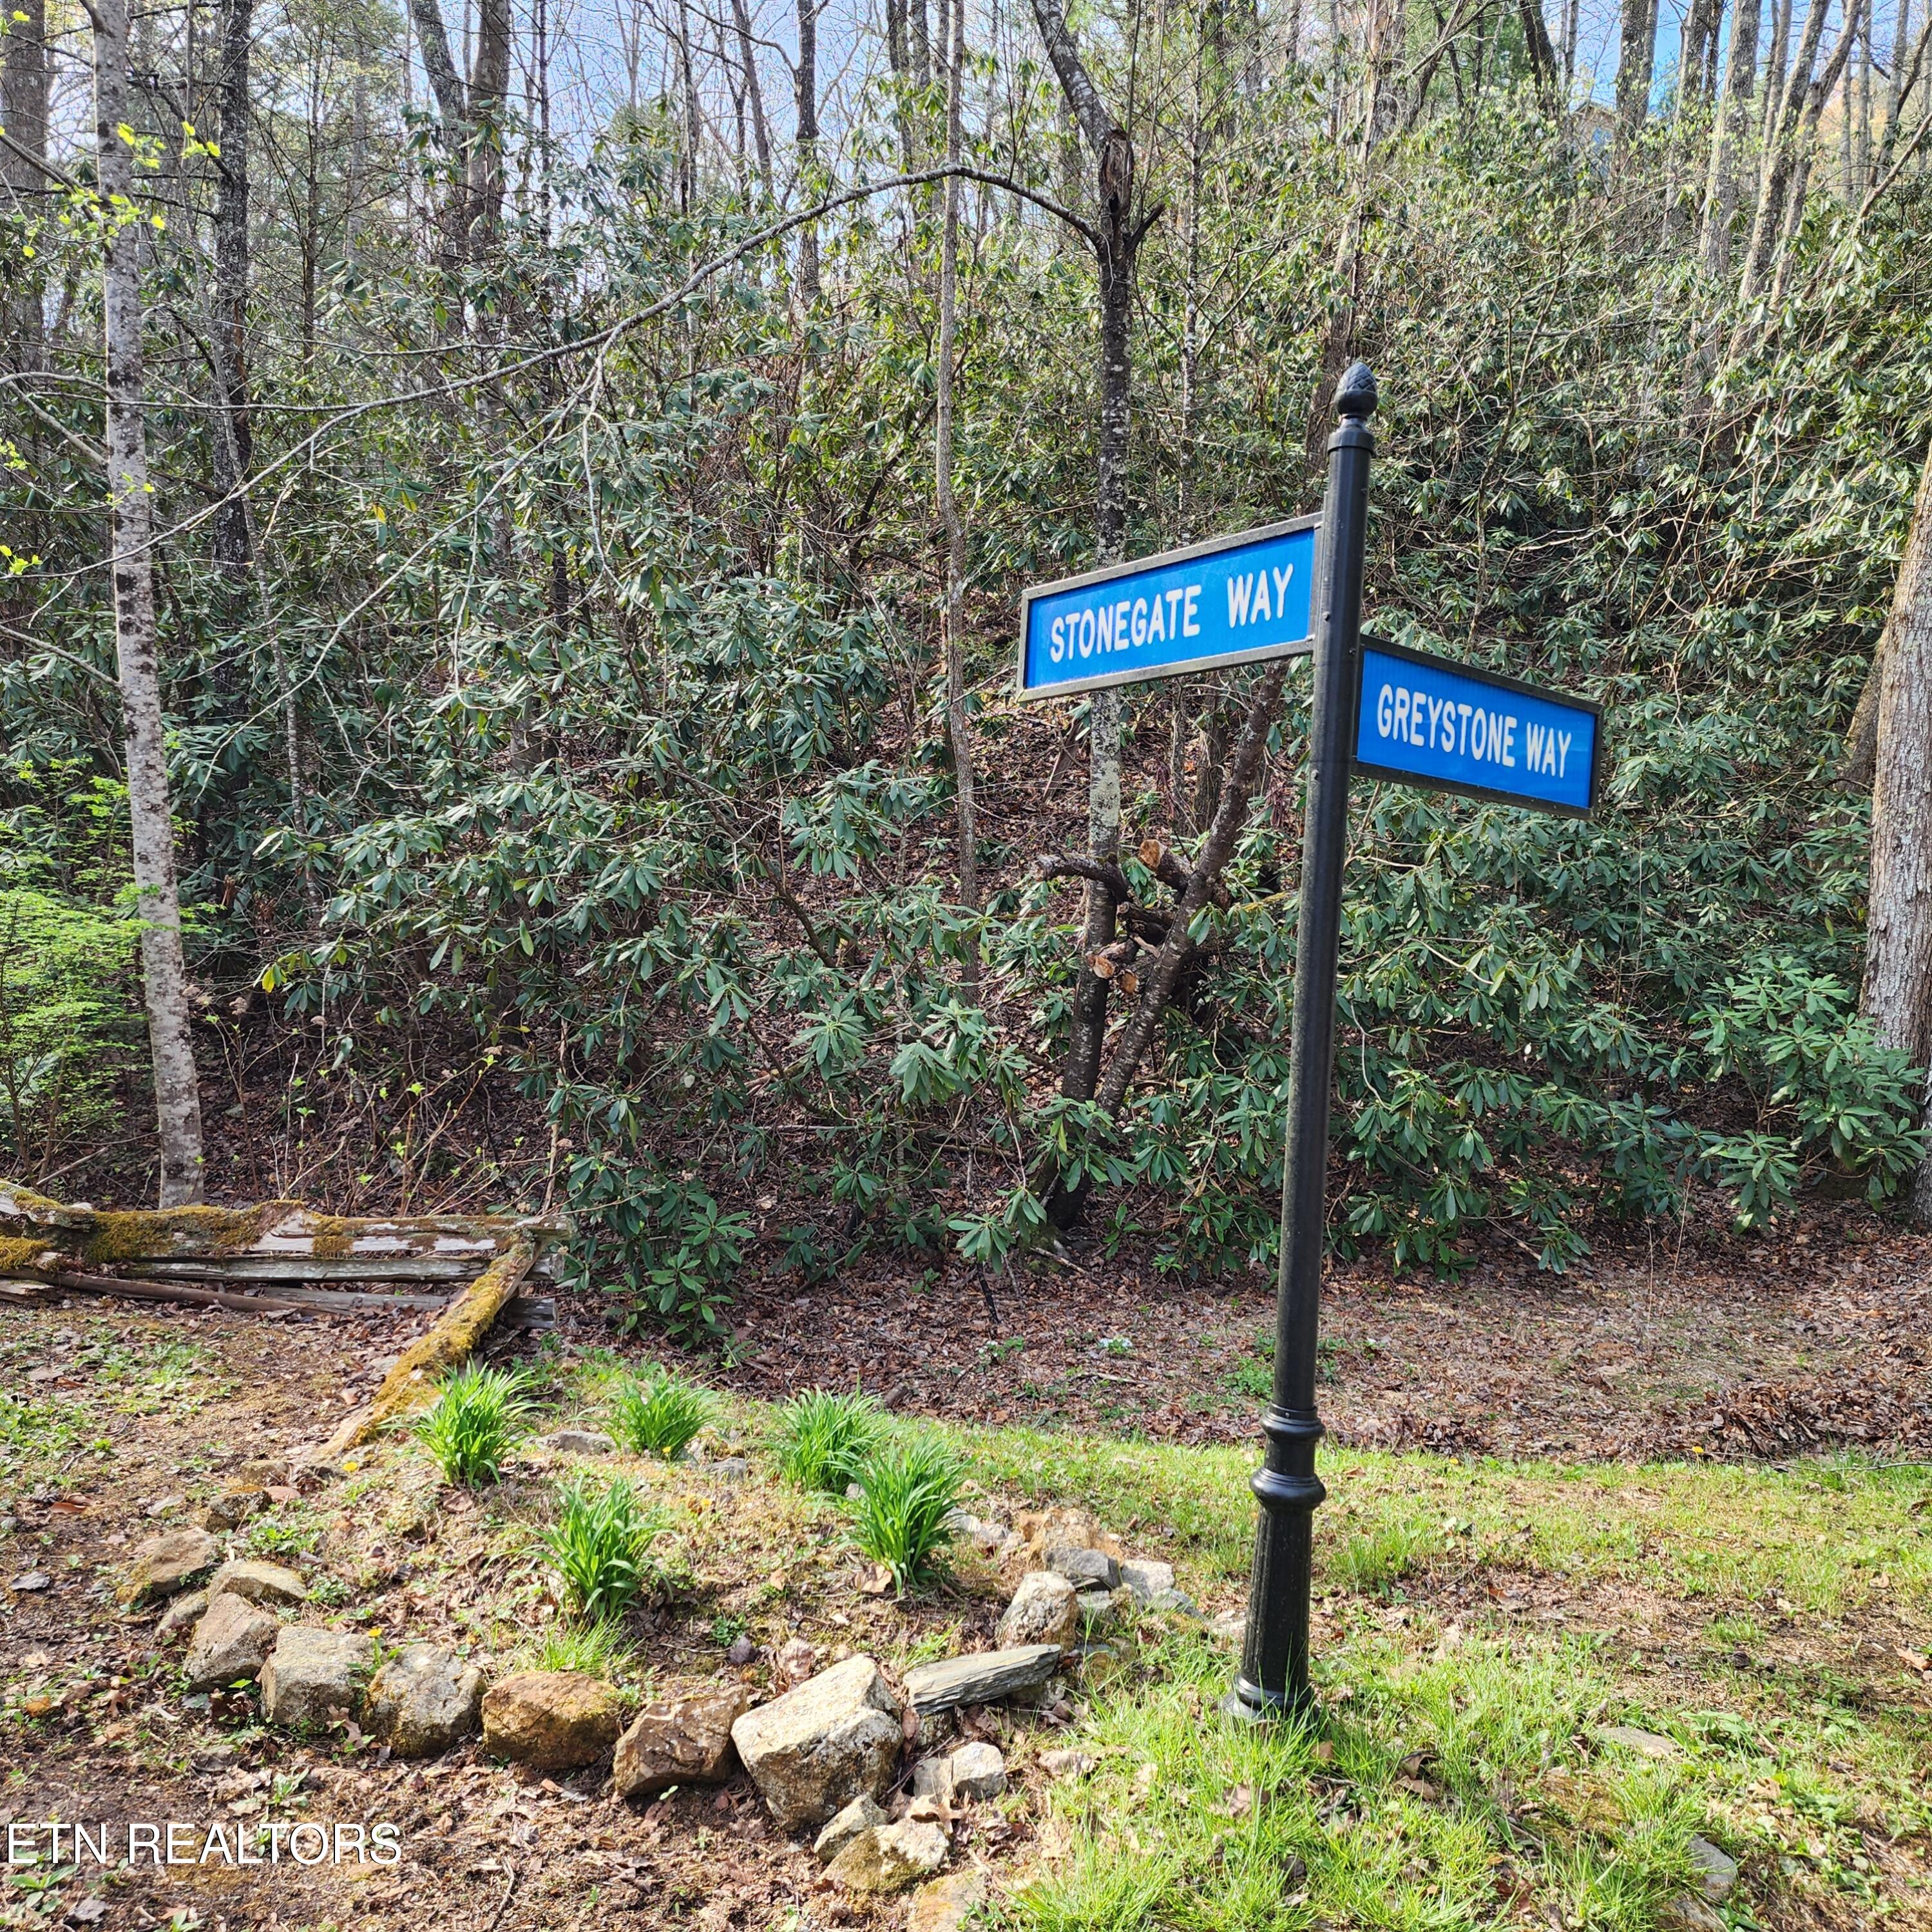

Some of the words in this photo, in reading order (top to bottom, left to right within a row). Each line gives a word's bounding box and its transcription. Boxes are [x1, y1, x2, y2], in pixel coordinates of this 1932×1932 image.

[1050, 584, 1201, 663] STONEGATE
[1227, 564, 1294, 628] WAY
[1377, 684, 1517, 767] GREYSTONE
[1527, 722, 1571, 778] WAY
